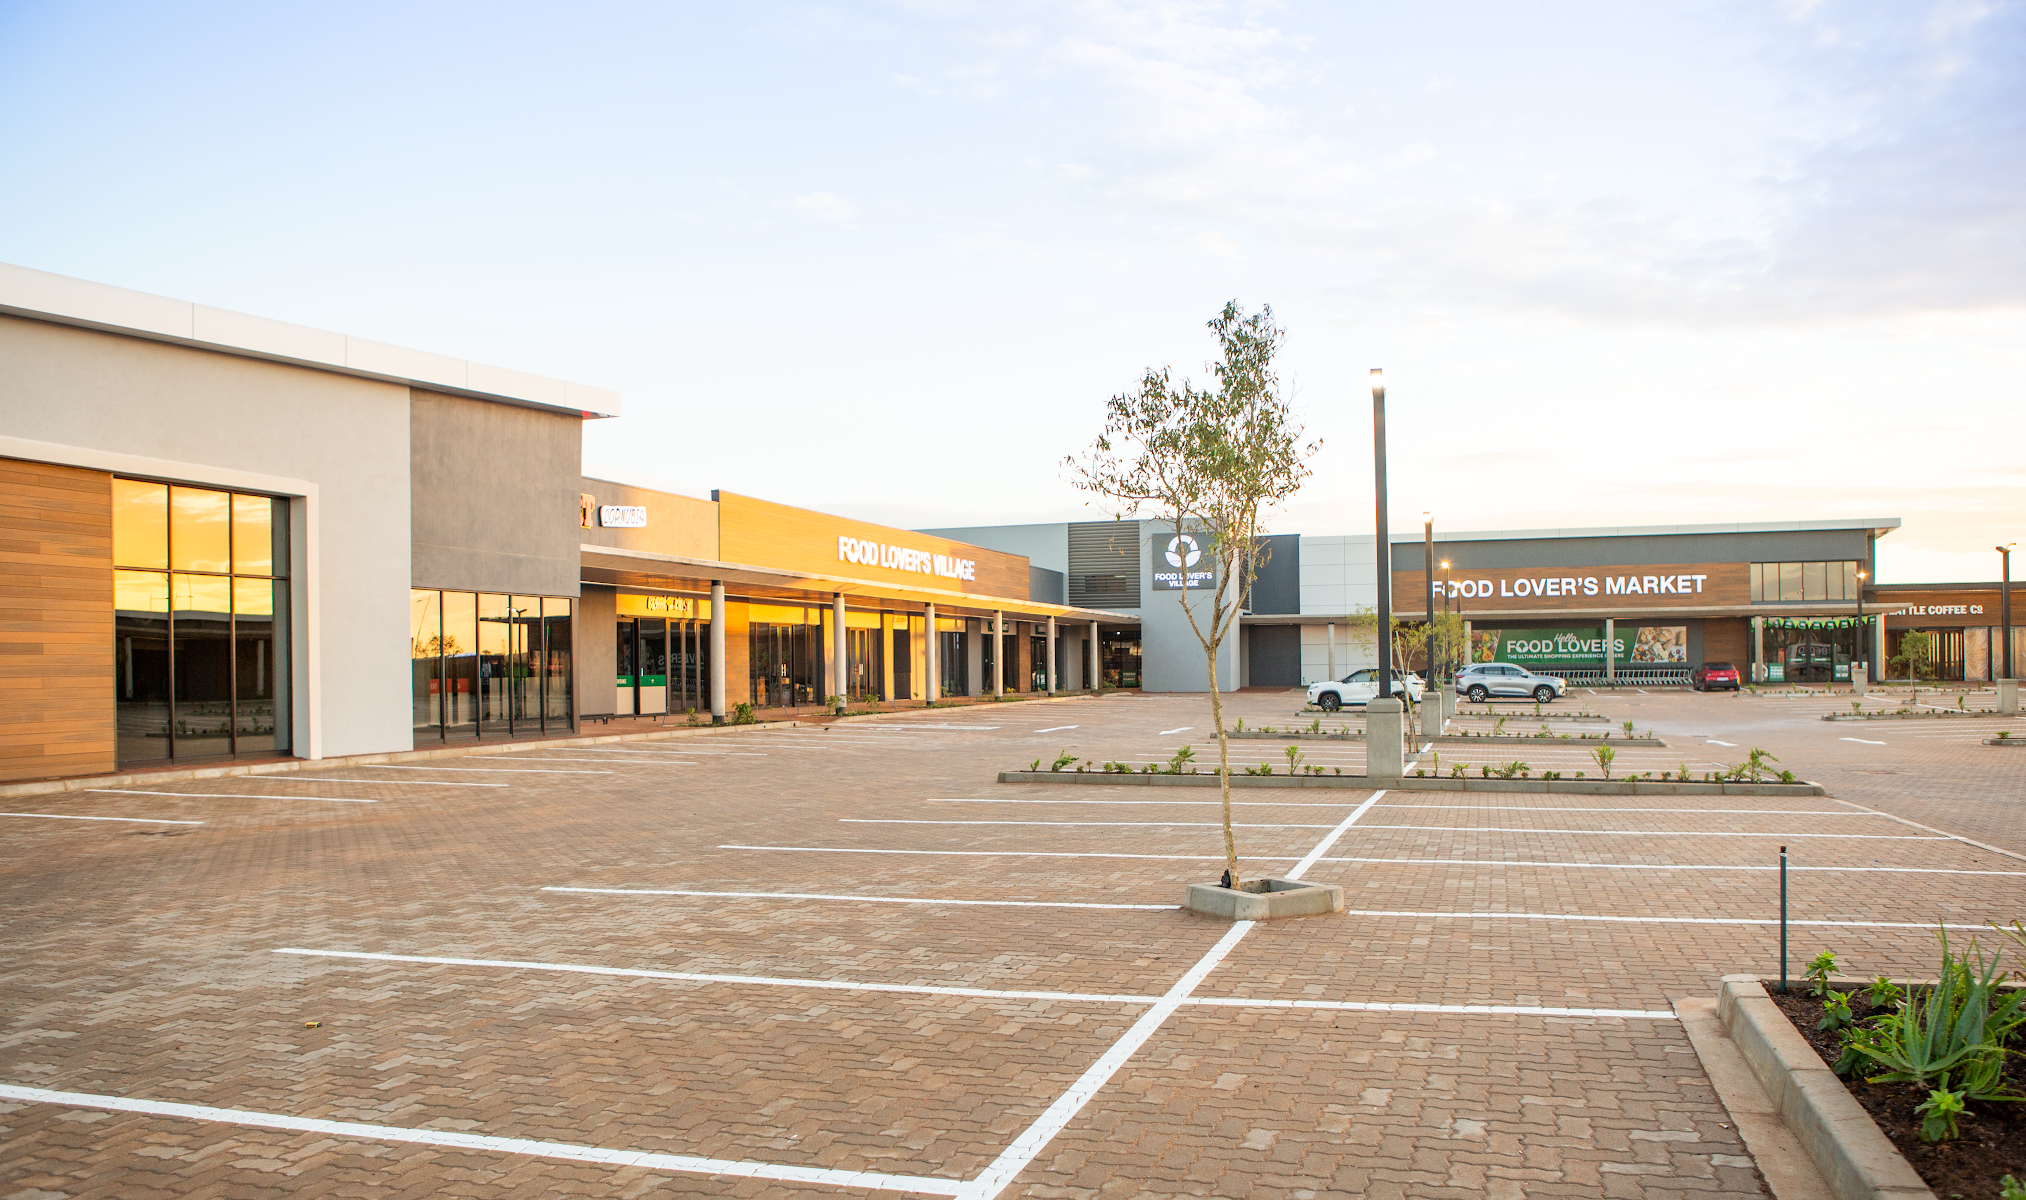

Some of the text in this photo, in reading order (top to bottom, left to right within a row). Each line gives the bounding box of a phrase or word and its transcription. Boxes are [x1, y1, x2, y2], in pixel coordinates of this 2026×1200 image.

[604, 508, 644, 524] CORNUBIA
[838, 536, 975, 581] FOOD LOVER'S VILLAGE
[1154, 571, 1213, 581] FOOD LVER'S
[1432, 575, 1708, 598] FOOD LOVER'S MARKET
[1884, 605, 1926, 615] ATTLE
[1927, 605, 1967, 614] COFFEE
[1553, 632, 1577, 643] Hello
[1507, 640, 1553, 653] FOOD
